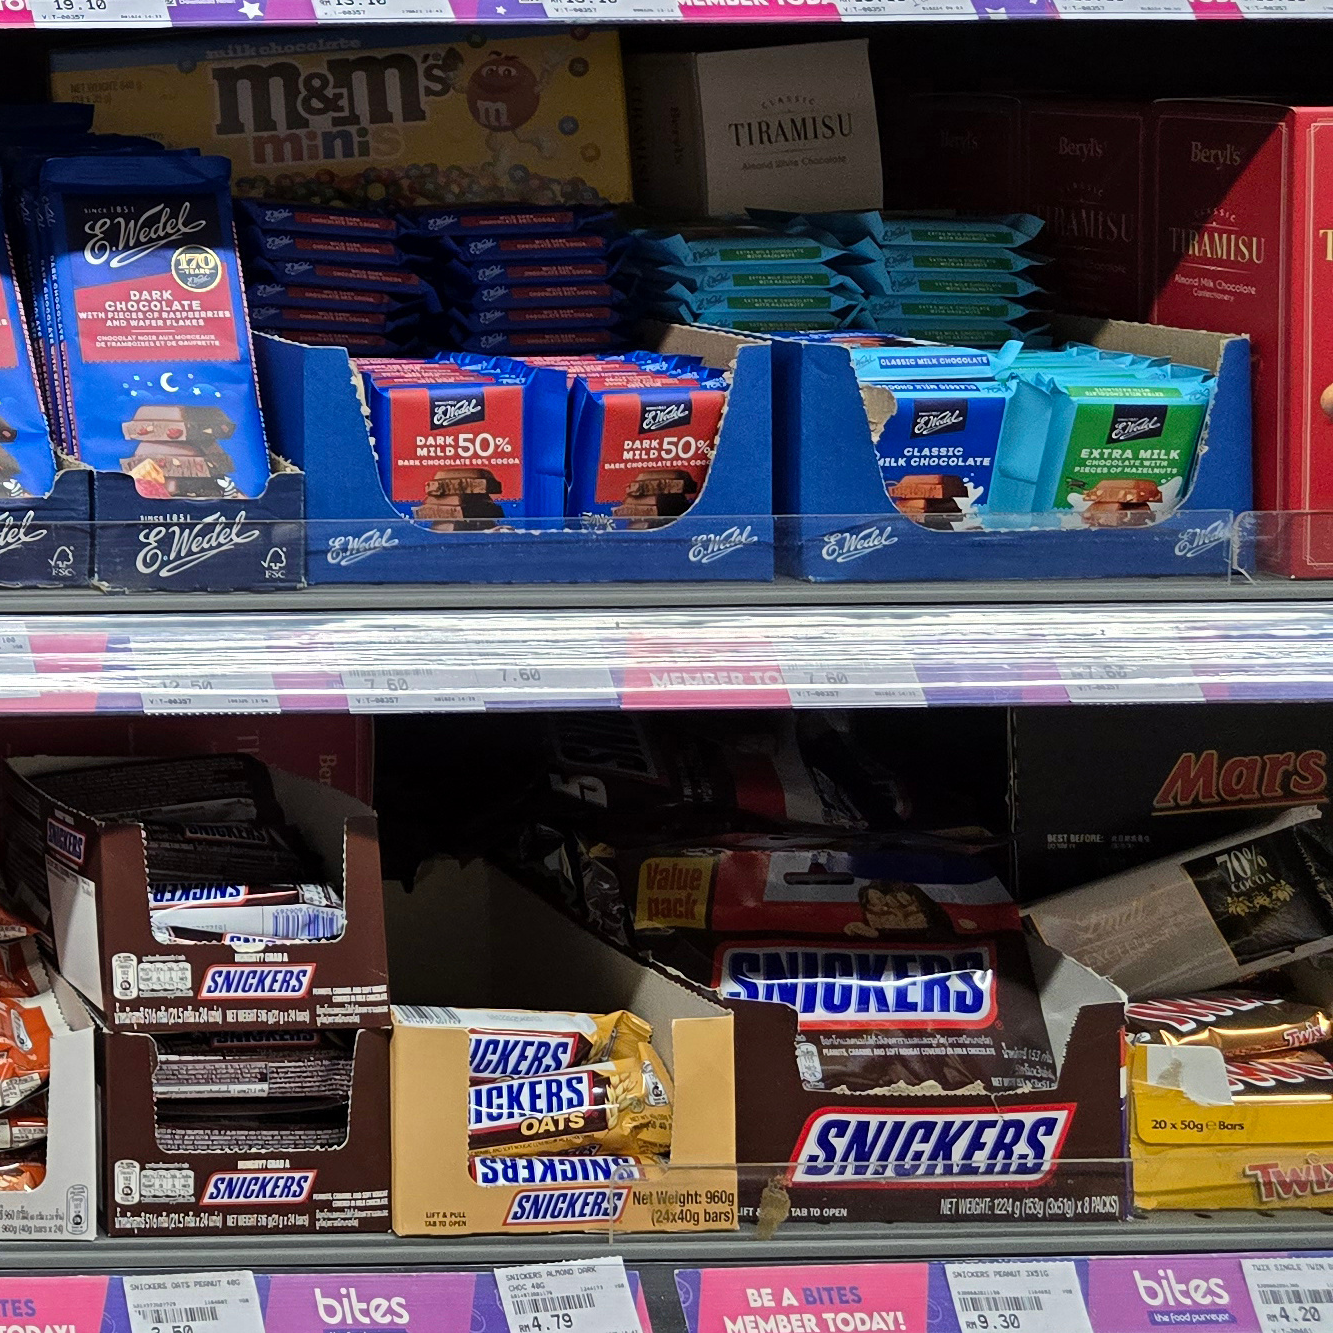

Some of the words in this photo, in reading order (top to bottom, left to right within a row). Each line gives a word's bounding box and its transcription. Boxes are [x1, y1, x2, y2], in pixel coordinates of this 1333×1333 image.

[53, 0, 107, 11] 19.10
[213, 50, 455, 137] m&m's
[250, 124, 404, 166] minis
[729, 112, 853, 149] TIRAMISU
[84, 202, 206, 269] E.Wedel
[1169, 226, 1265, 264] TIRAMISU
[177, 253, 215, 269] 170
[458, 433, 512, 457] 50%
[1081, 449, 1132, 460] EXTRA
[1138, 449, 1179, 460] MILK
[1155, 749, 1328, 806] Mars
[644, 862, 701, 895] Value
[647, 893, 693, 924] pack
[207, 969, 308, 994] SNICKERS
[519, 1111, 585, 1135] OATS
[1151, 1119, 1164, 1131] 20
[1167, 1122, 1175, 1131] x
[1177, 1119, 1204, 1134] 50g
[1218, 1119, 1245, 1131] Bars
[805, 1117, 1055, 1177] SNICKERS
[508, 1190, 623, 1220] SNICKERS
[939, 1198, 959, 1215] NET
[961, 1198, 992, 1215] WEIGHT:
[994, 1198, 1013, 1215] 1224
[314, 1287, 410, 1325] bites
[977, 1314, 1021, 1329] 9.30
